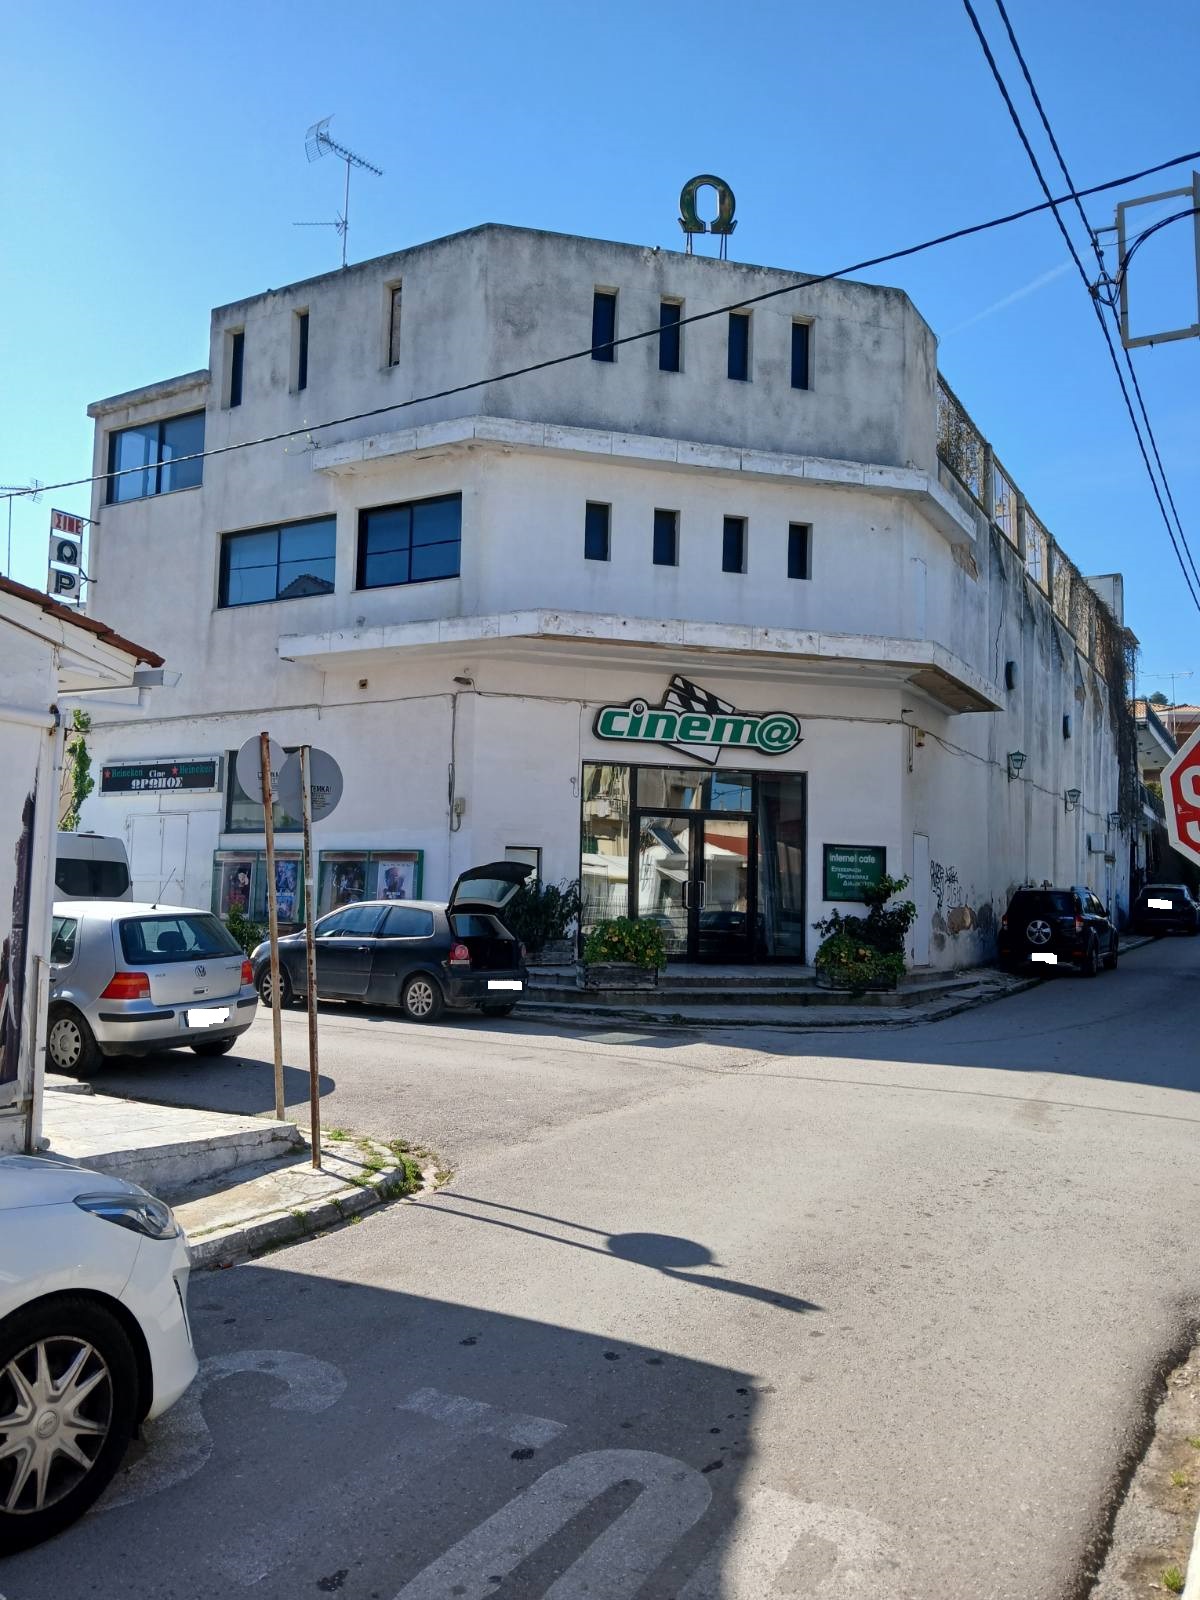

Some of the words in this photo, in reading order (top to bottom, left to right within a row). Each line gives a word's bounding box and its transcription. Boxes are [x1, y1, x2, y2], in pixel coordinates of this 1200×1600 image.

[599, 703, 797, 753] cinem@
[111, 767, 143, 778] Heineken
[179, 764, 213, 775] Heineken
[131, 776, 183, 790] ΩΡΩΠΟΣ
